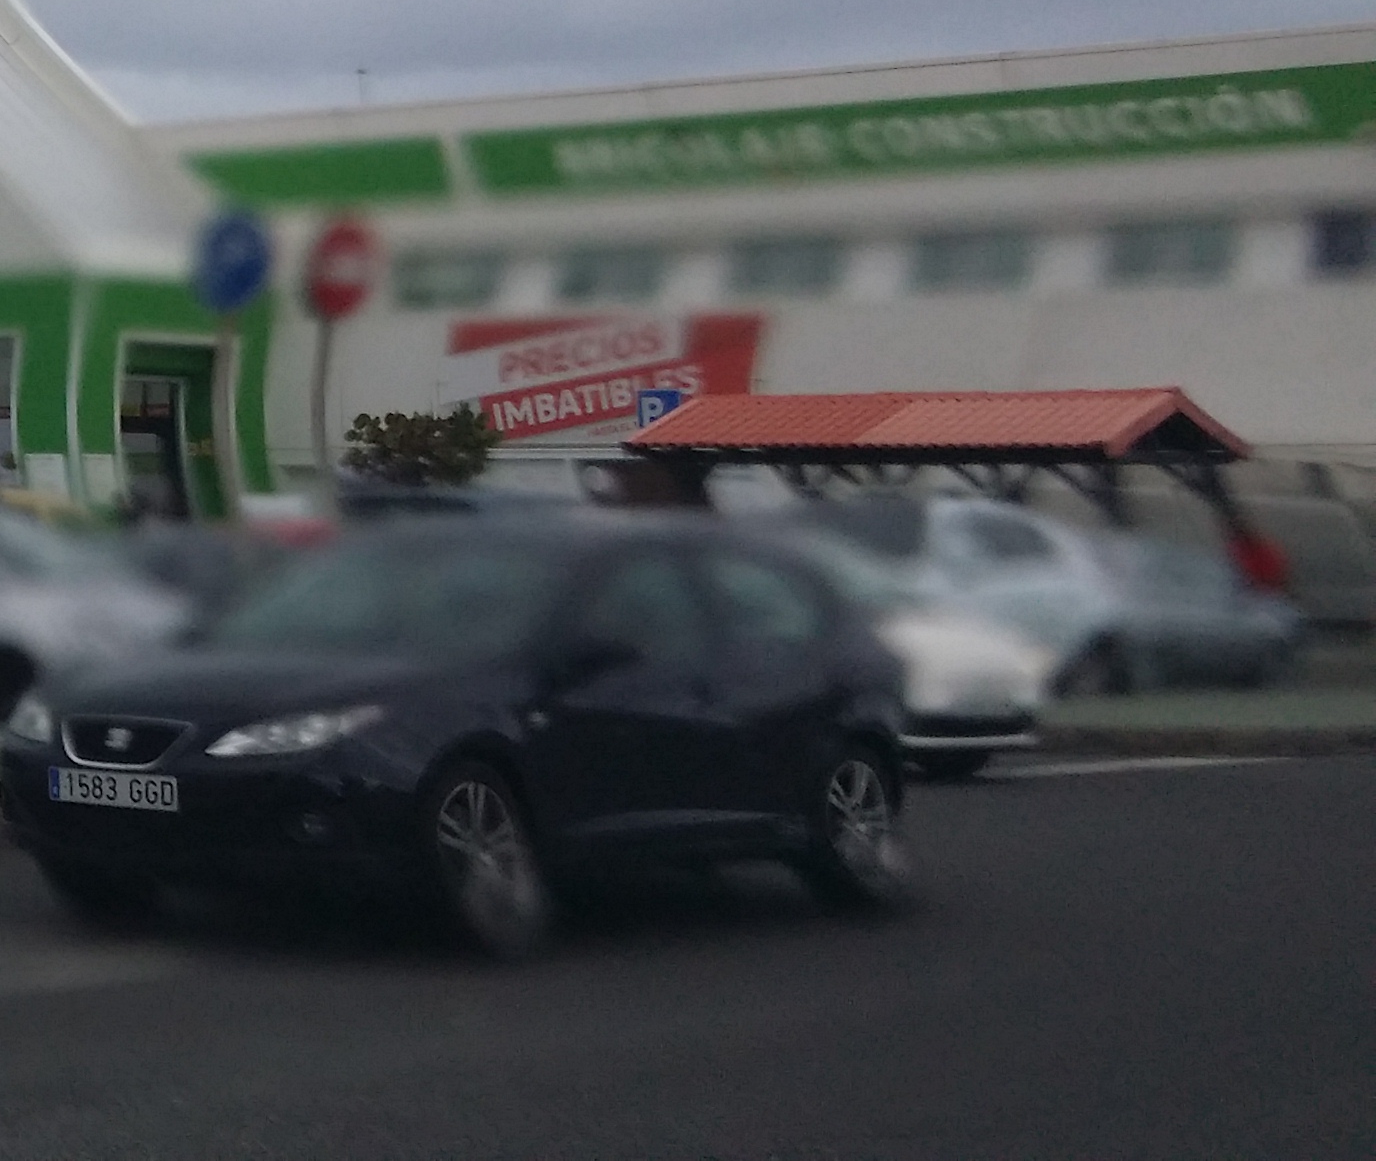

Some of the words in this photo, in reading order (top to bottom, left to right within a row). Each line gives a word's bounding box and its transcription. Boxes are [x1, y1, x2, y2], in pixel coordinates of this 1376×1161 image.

[848, 85, 1314, 162] CONSTRUCCIÓN
[66, 771, 118, 801] 1583
[129, 778, 174, 806] GGD
